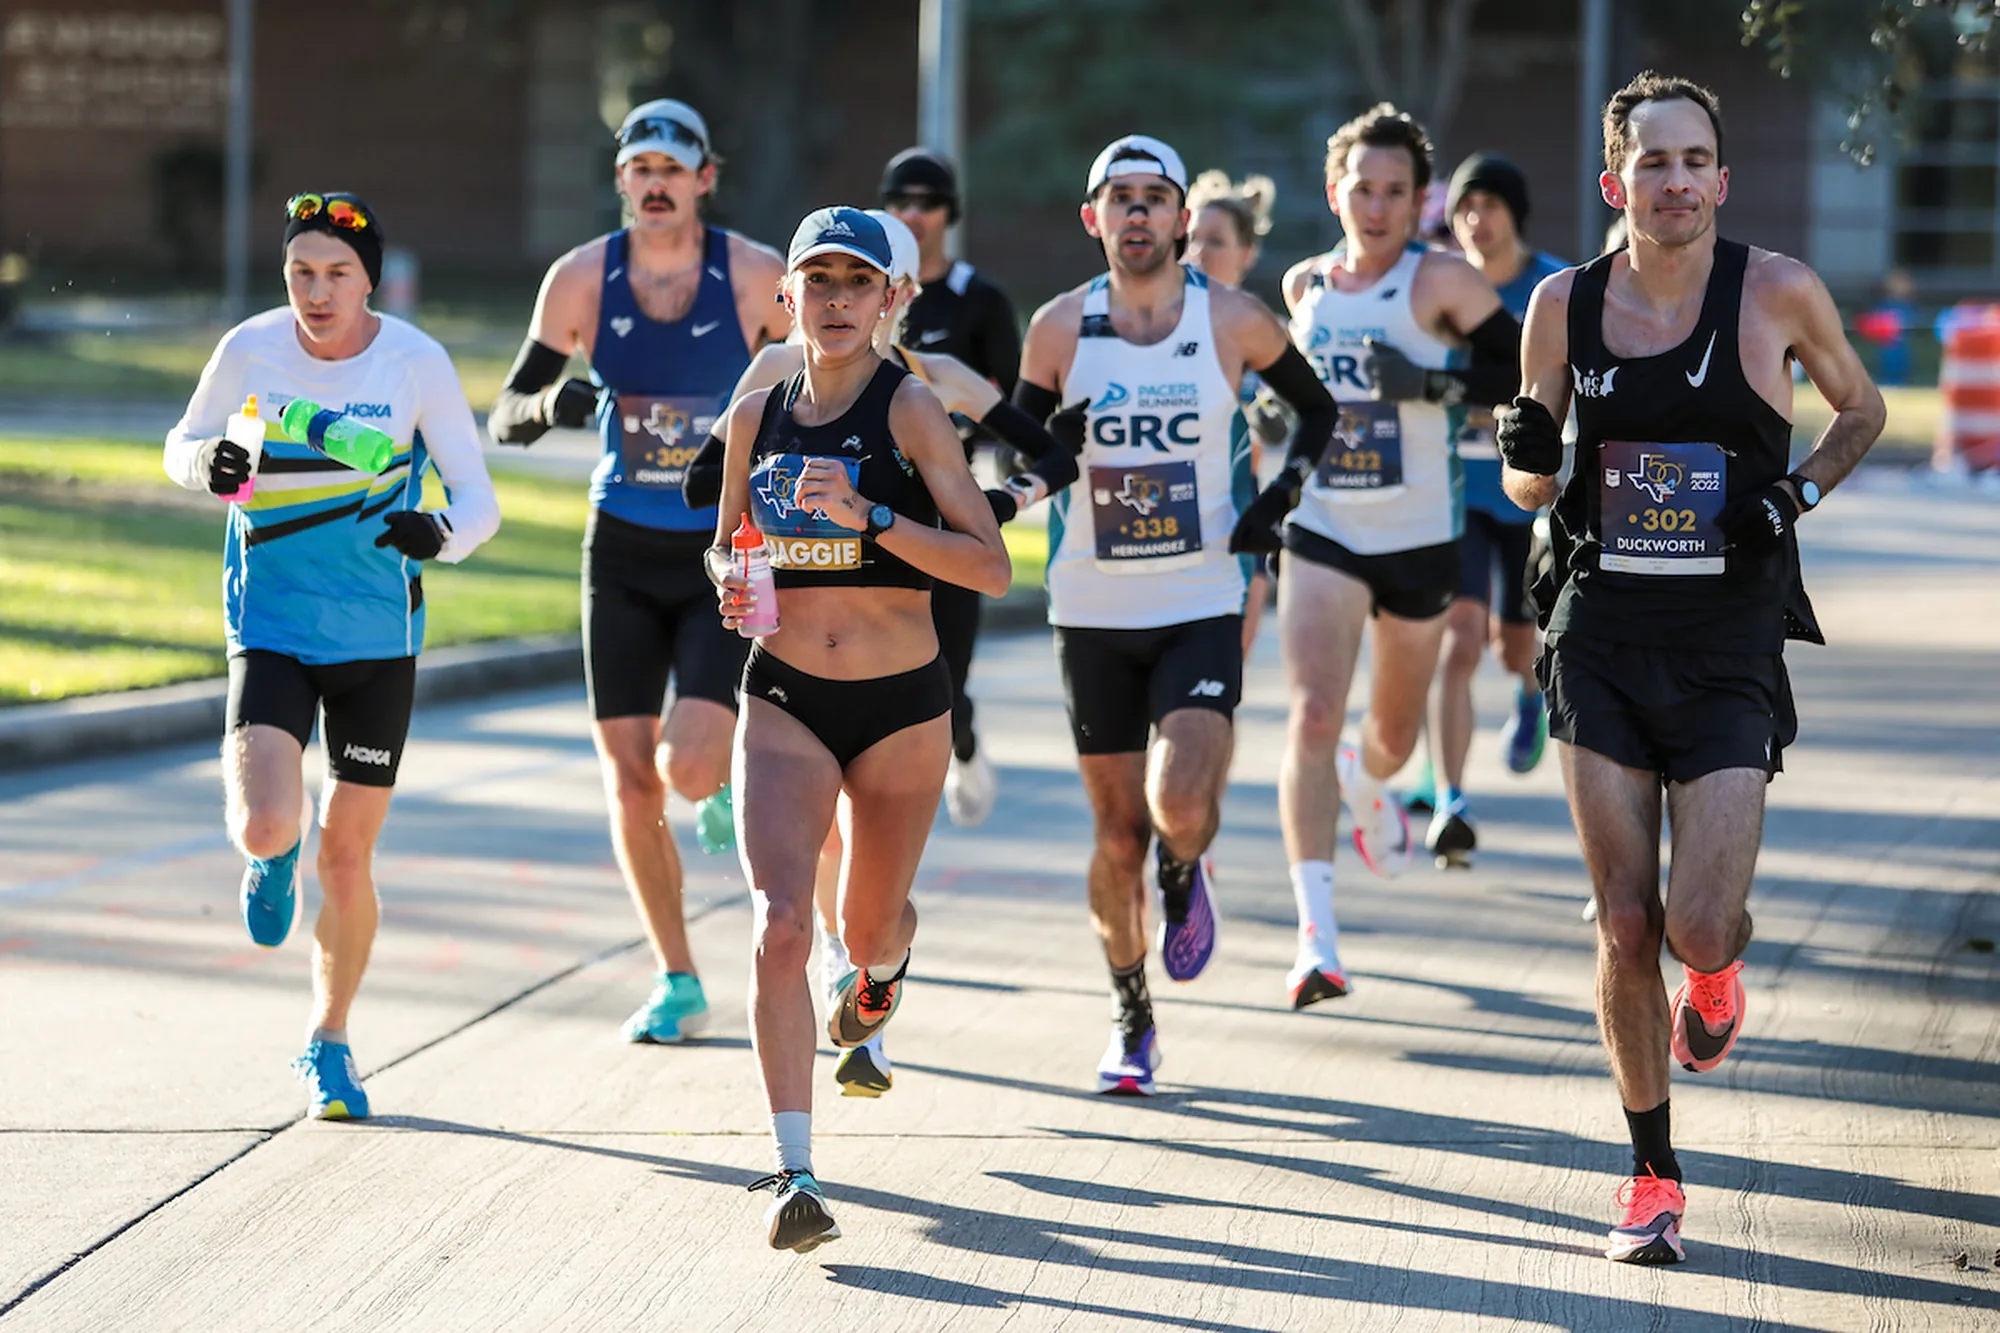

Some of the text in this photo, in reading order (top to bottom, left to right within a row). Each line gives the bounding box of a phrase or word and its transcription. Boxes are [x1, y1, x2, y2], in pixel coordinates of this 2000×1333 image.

[1137, 383, 1198, 397] PACERS
[344, 402, 392, 418] HOKA
[1137, 398, 1198, 409] RUNNING
[1093, 412, 1200, 454] GRC
[1690, 480, 1720, 490] 2022
[1132, 516, 1178, 539] 338
[1642, 508, 1697, 531] 302
[1110, 540, 1187, 557] HERNANDEZ
[1616, 537, 1706, 552] DUCKWORTH
[343, 742, 391, 767] HOKA
